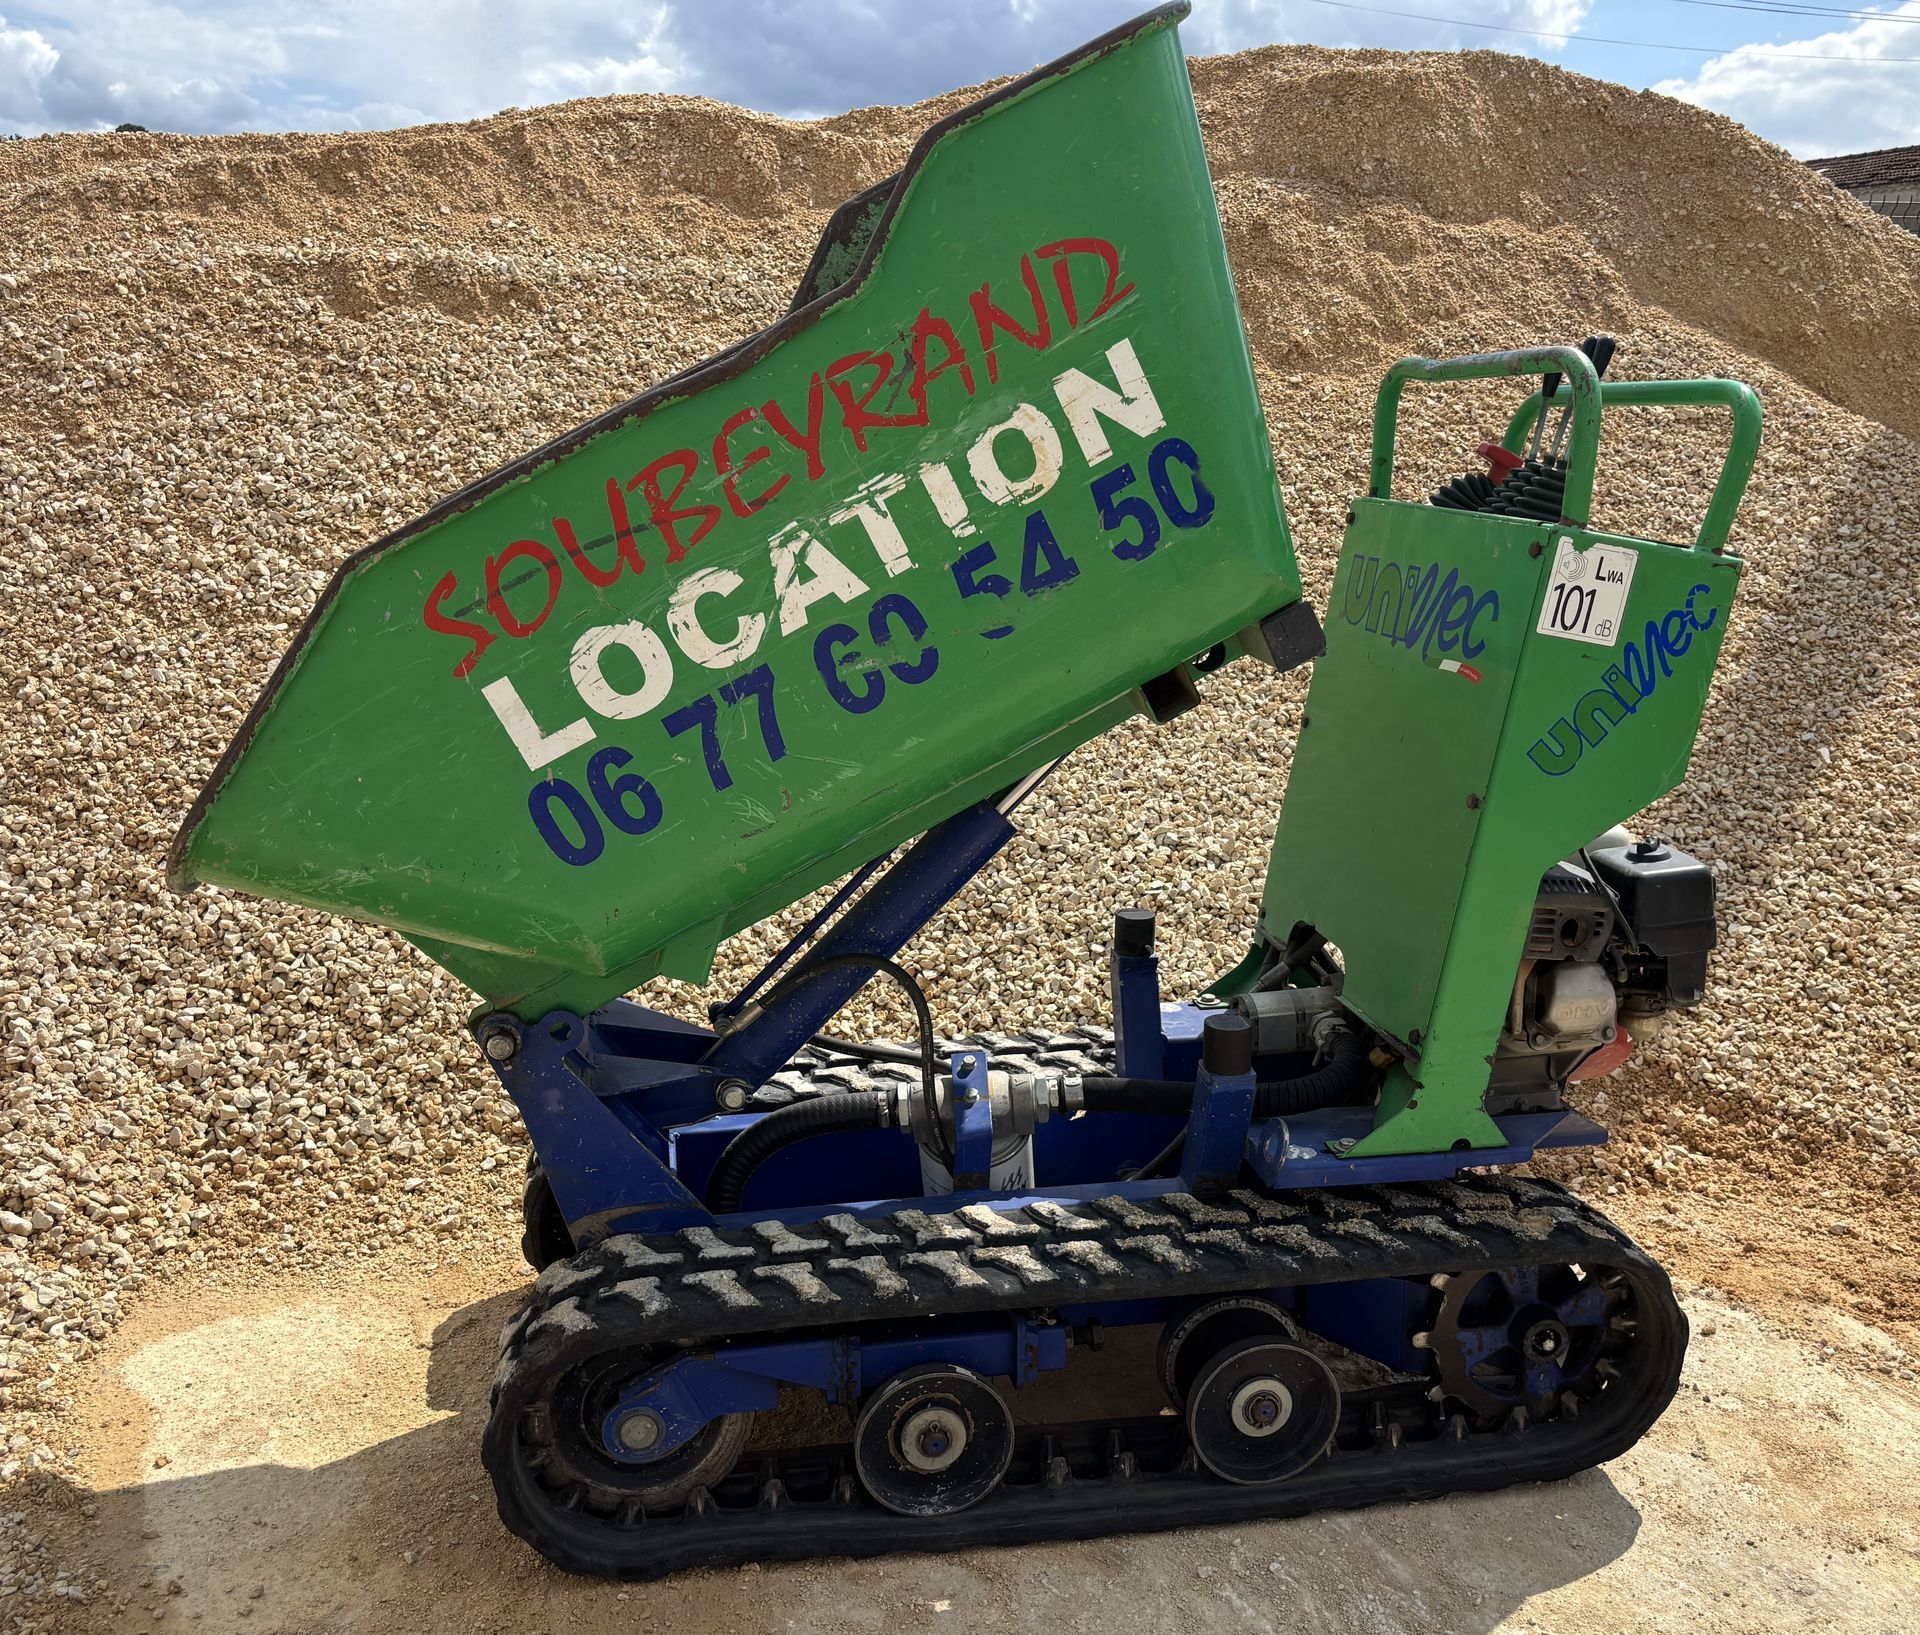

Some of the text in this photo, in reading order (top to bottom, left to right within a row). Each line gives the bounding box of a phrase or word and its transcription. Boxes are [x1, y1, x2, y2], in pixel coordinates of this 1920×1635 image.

[422, 237, 1136, 677] SOUBEYRAND
[481, 337, 1166, 771] LOCATION
[527, 437, 1216, 867] 06 77 60 54 50
[1550, 583, 1613, 637] 101 dB
